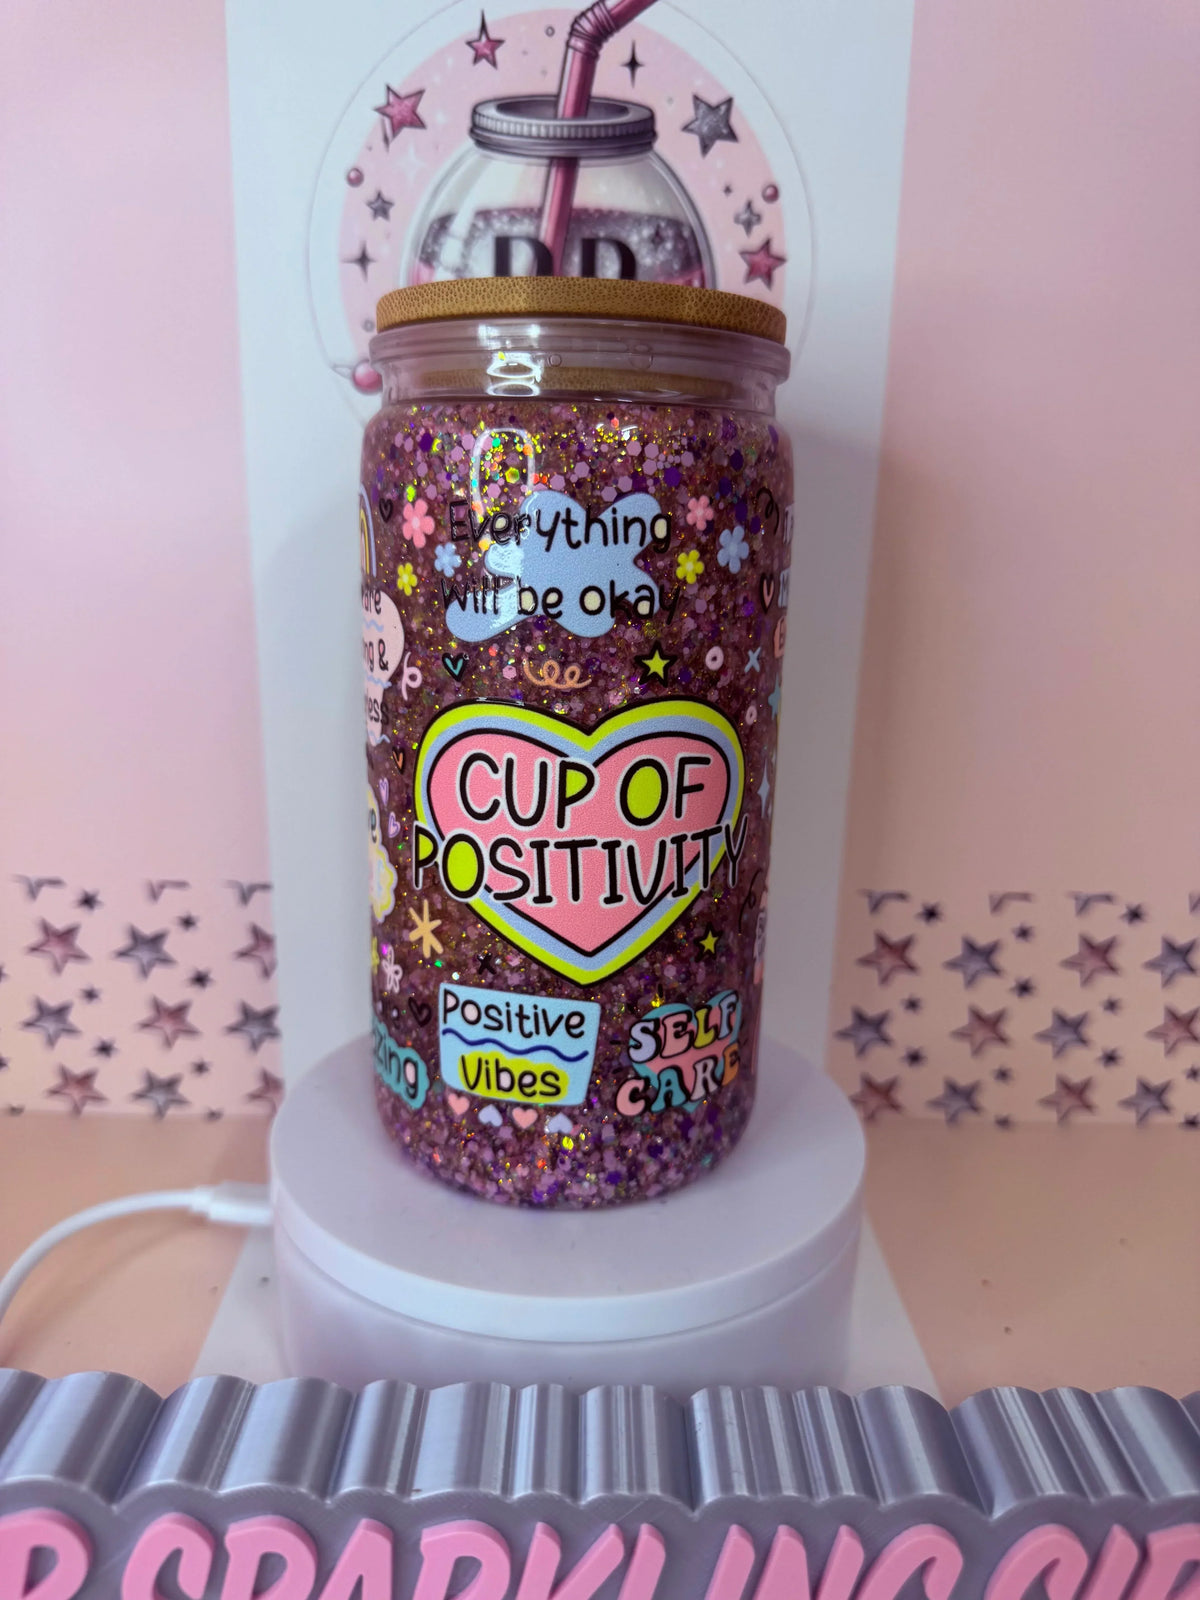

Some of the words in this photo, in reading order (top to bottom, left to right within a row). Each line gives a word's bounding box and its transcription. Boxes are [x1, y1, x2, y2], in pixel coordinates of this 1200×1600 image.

[450, 500, 672, 553] Everything
[517, 575, 563, 618] be
[579, 579, 681, 625] okay
[457, 750, 597, 830] CUP
[618, 754, 712, 827] OF
[412, 814, 749, 905] POSITIVITY
[442, 988, 586, 1039] Positive
[628, 990, 739, 1063] SELF
[459, 1053, 563, 1098] Vibes
[615, 1041, 740, 1118] CARE
